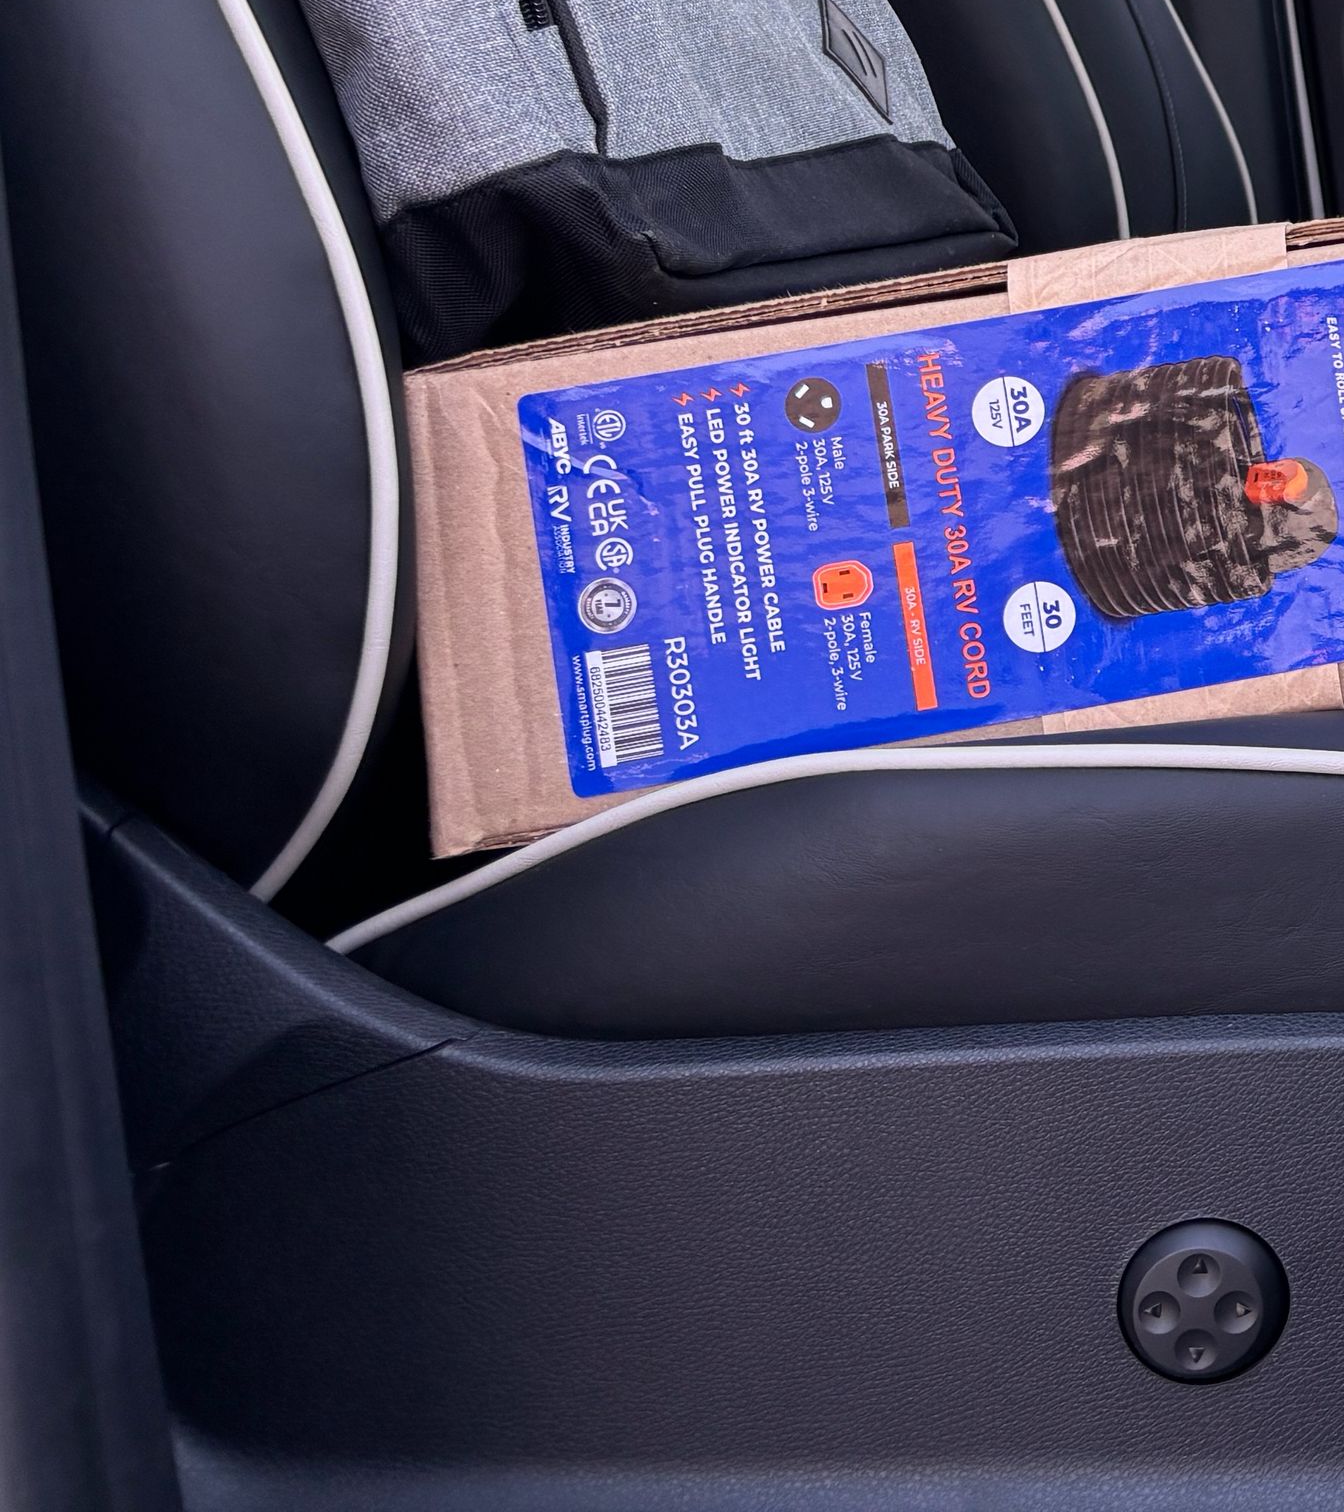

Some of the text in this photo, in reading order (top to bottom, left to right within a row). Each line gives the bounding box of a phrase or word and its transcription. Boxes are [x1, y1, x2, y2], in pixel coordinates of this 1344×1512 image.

[1327, 317, 1341, 349] EASY
[1332, 352, 1344, 369] TO
[576, 414, 589, 445] Intertek
[989, 399, 1003, 429] 125V
[1010, 386, 1032, 433] 30A
[548, 418, 571, 474] ABYC
[830, 437, 846, 469] Male
[876, 401, 899, 489] 30A PARK SIDE
[581, 455, 621, 498] CE
[795, 441, 818, 531] 2-pole 3-wire
[813, 439, 834, 504] 30A, 125V
[547, 485, 575, 573] RV INDUSTRY
[588, 502, 609, 536] CA
[607, 499, 628, 532] UK
[678, 413, 726, 644] EASY PULL PLUG HANDLE
[734, 403, 785, 652] 30 ft 30A RV POWER CABLE
[917, 351, 990, 698] HEAVY DUTY 30A RV CORD
[706, 408, 761, 680] LED POWER INDICATOR LIGHT
[604, 599, 621, 607] 7
[905, 587, 917, 610] 30A
[1020, 603, 1035, 636] FEET
[1043, 600, 1062, 629] 30
[841, 614, 863, 680] 30A, 125V
[859, 612, 877, 663] Female
[910, 619, 921, 635] RV
[823, 617, 848, 710] 2-pole, 3-wire
[913, 638, 926, 665] SIDE
[572, 655, 596, 771] www.smartplug.com
[664, 637, 699, 750] R30303A
